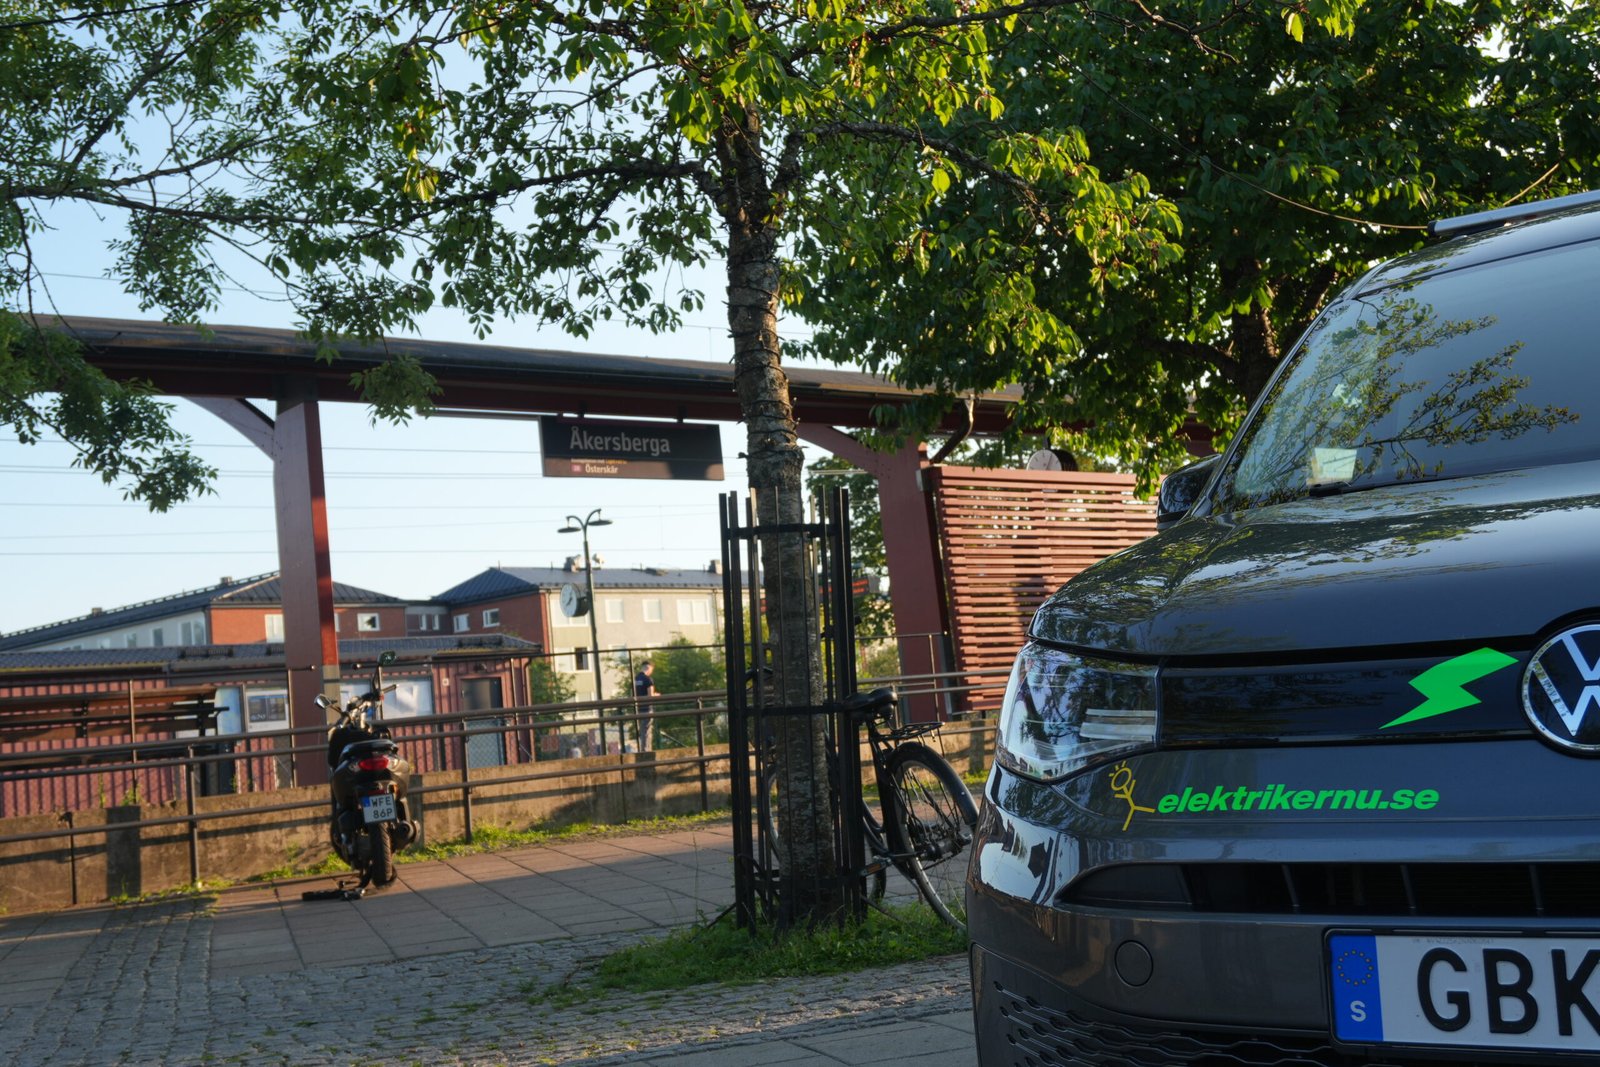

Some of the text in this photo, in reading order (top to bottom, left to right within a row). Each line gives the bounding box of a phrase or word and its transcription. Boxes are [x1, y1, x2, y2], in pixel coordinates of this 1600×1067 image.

[570, 426, 670, 456] Åkersberga
[371, 797, 391, 807] WFE
[1157, 783, 1440, 813] elektrikernu.se
[373, 808, 392, 818] 86P
[1349, 1000, 1367, 1022] S
